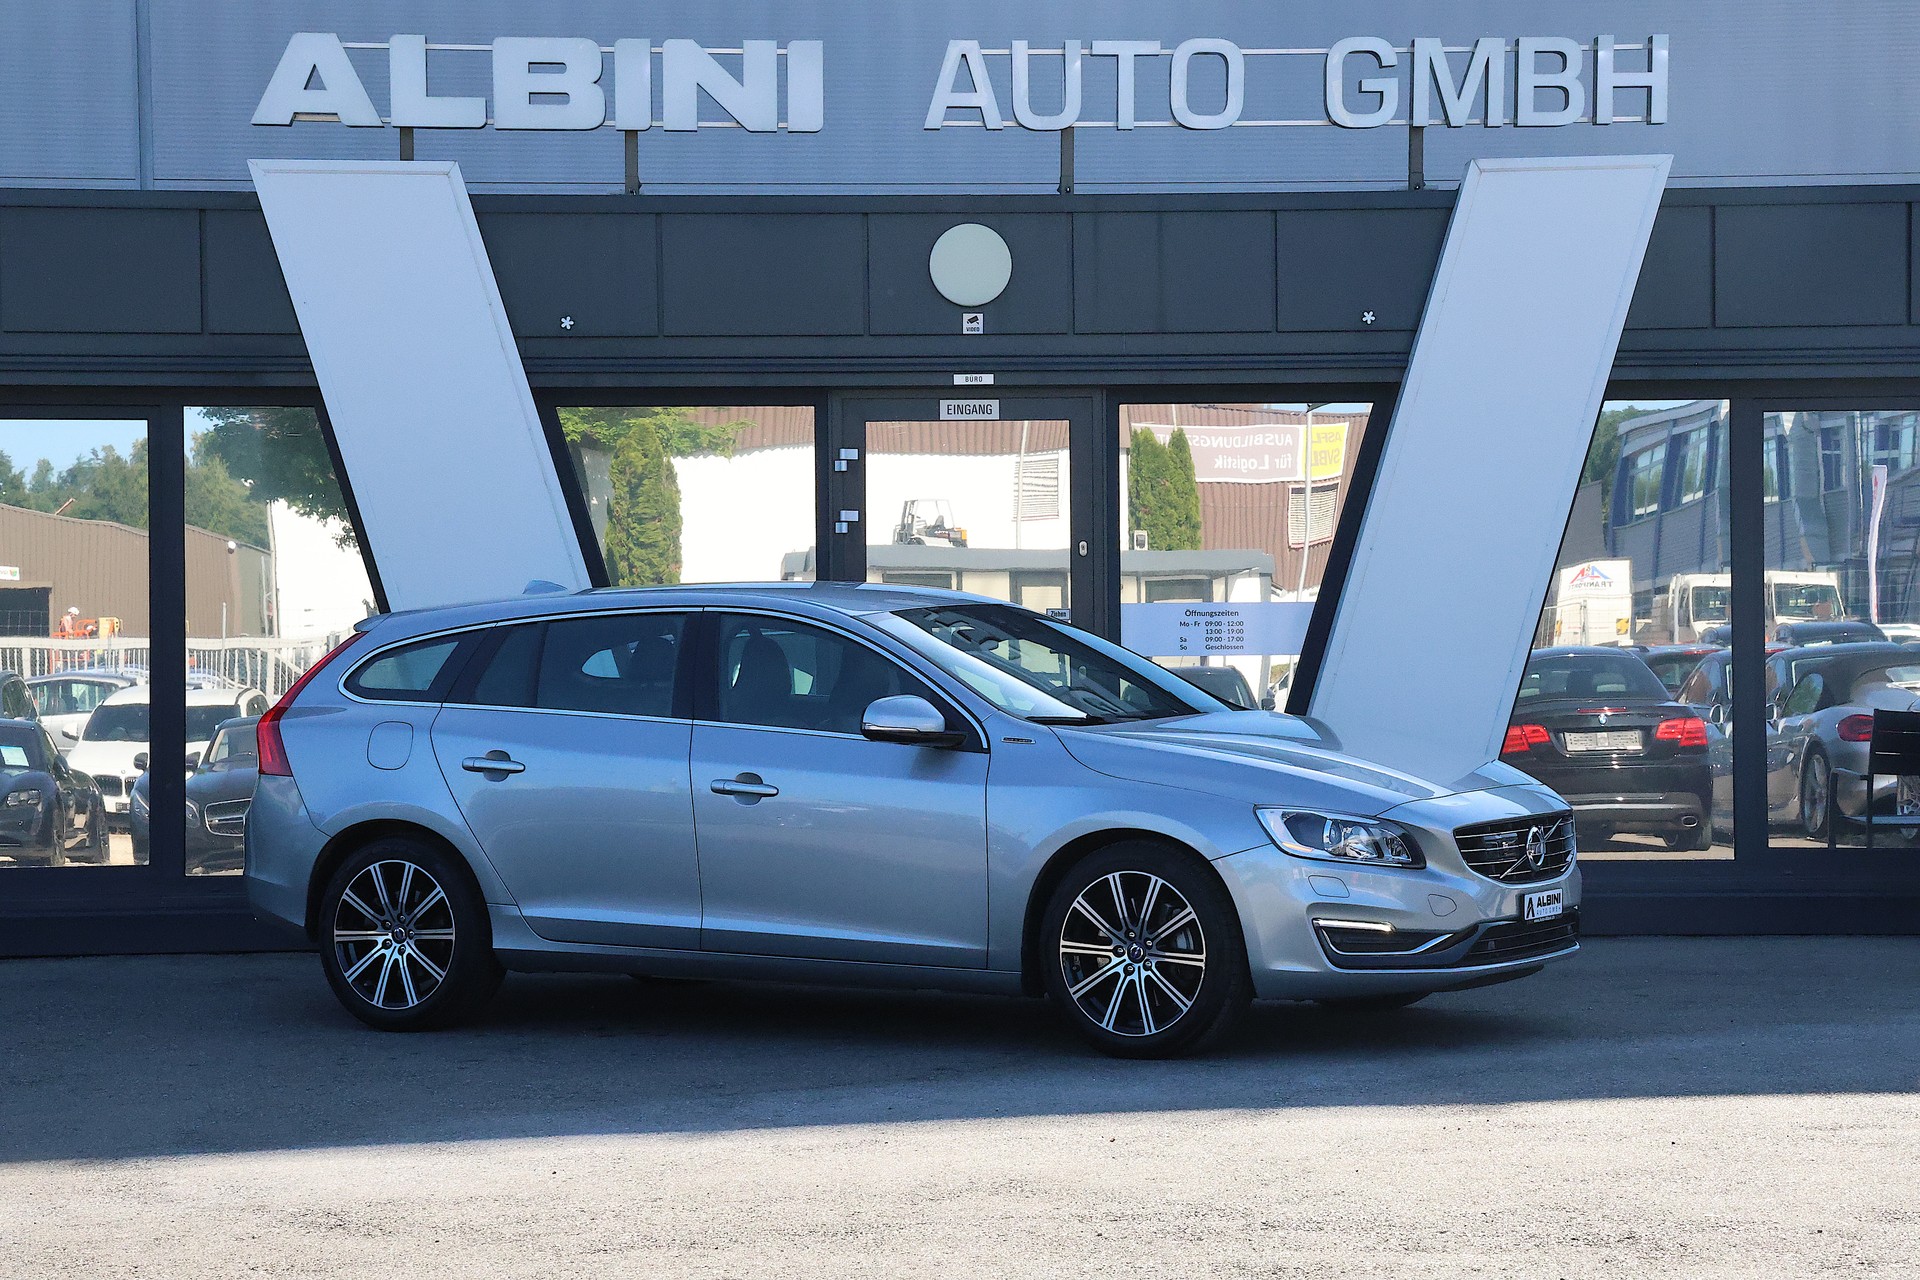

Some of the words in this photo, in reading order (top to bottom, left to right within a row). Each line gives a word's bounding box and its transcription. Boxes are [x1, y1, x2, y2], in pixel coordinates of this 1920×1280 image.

[250, 32, 823, 133] ALBINI
[923, 37, 1245, 131] AUTO
[1325, 33, 1669, 129] GMBH
[946, 403, 993, 415] EINGANG
[1184, 608, 1239, 618] Öffnungszeiten
[1536, 893, 1561, 908] ALBINI
